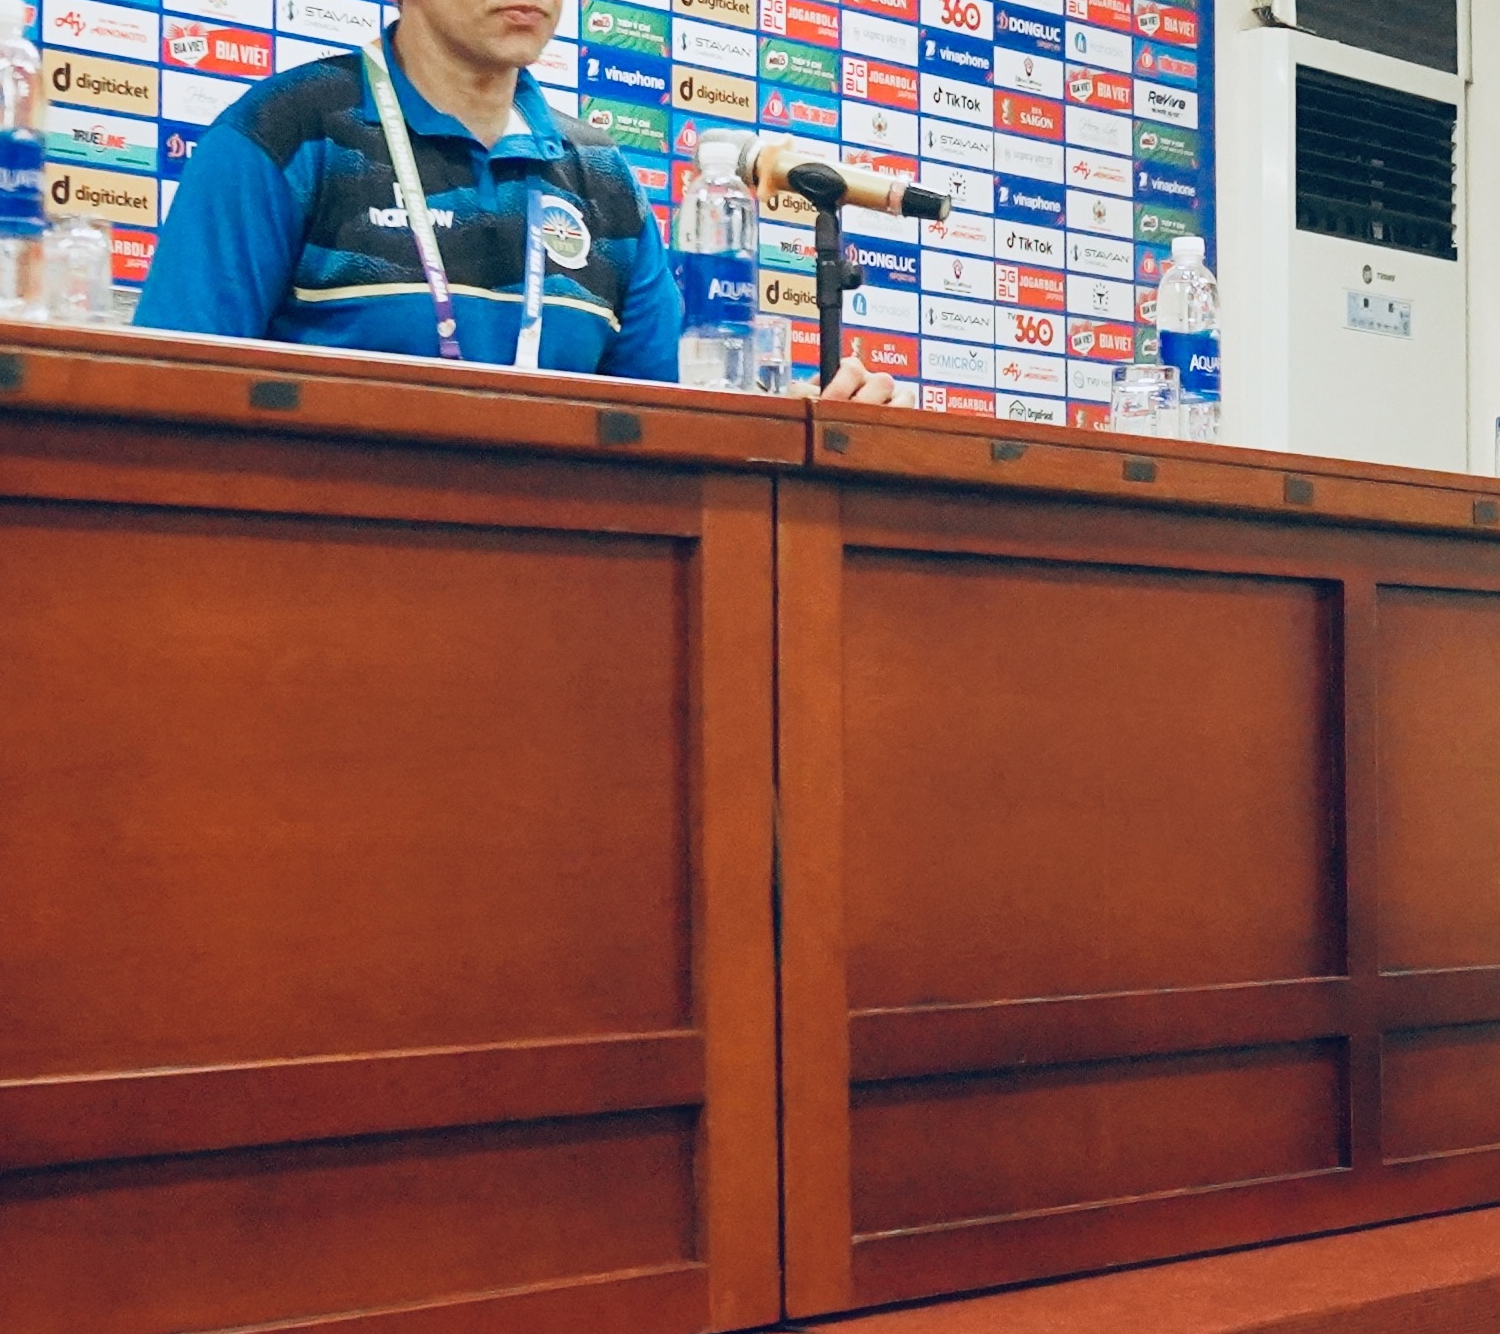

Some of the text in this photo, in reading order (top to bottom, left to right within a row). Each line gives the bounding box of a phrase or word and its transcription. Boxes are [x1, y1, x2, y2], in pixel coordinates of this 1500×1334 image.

[216, 40, 239, 62] BIA
[939, 46, 988, 69] vinaphone
[75, 72, 148, 98] digiticket
[605, 65, 664, 90] vinaphone
[696, 86, 749, 108] digiticket
[1014, 192, 1060, 212] vinaphone
[1099, 334, 1113, 350] BIA
